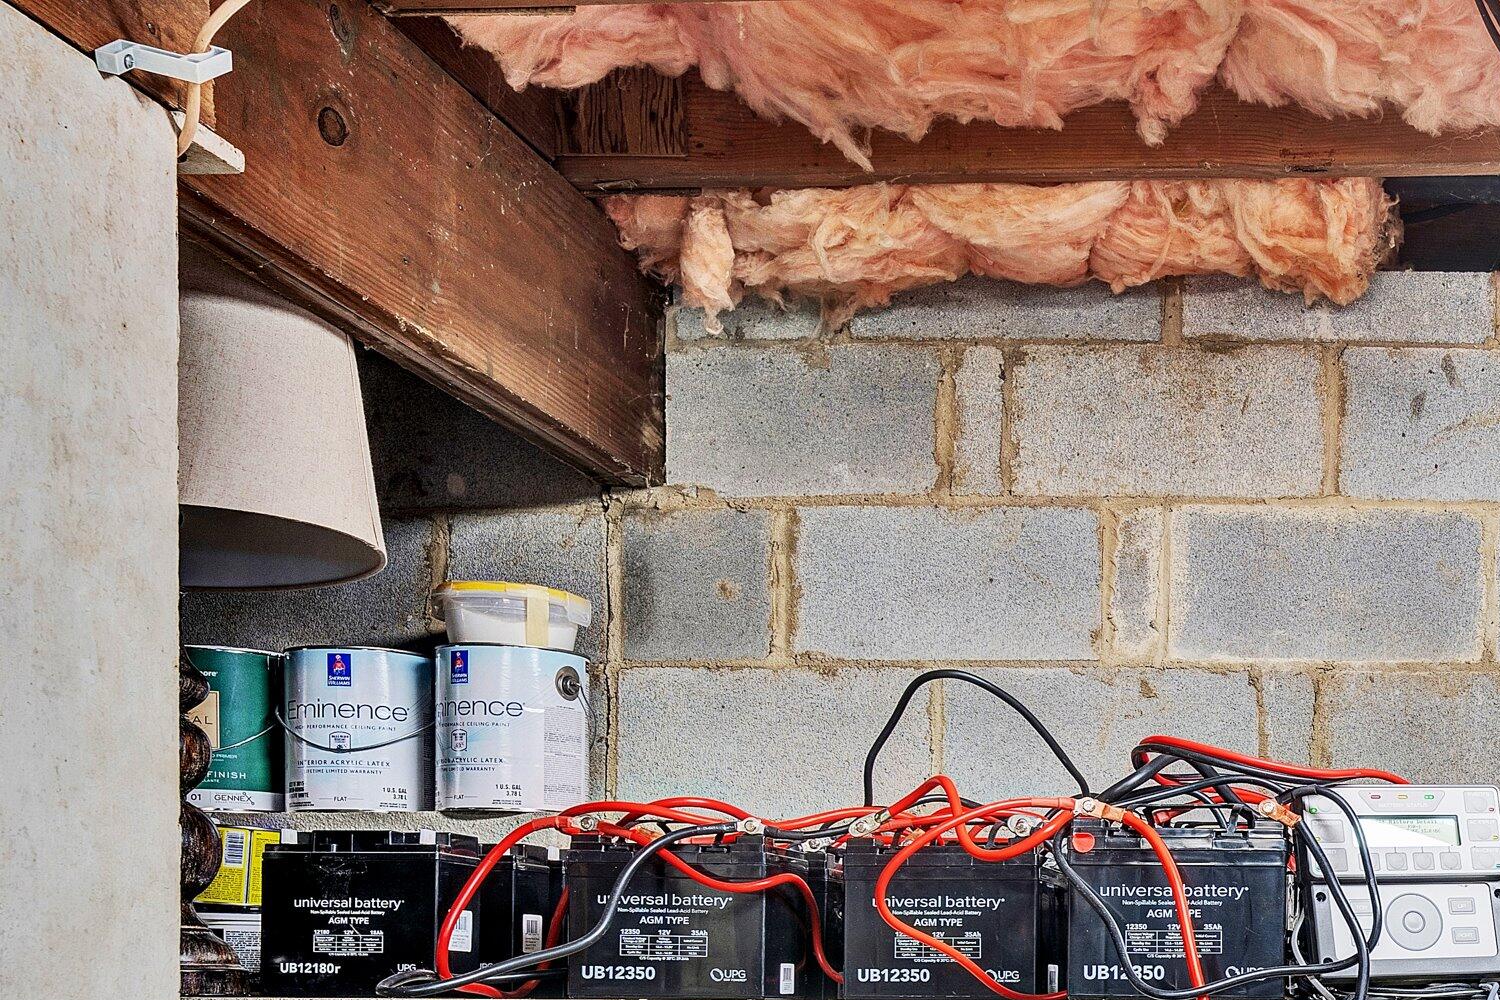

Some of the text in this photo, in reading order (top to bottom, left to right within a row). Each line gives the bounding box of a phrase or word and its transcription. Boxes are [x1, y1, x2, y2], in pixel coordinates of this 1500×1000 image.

[287, 698, 408, 722] Eminence
[206, 771, 247, 780] FINISH
[214, 792, 255, 805] GENNEX
[1099, 884, 1173, 897] universa
[293, 897, 402, 911] universal battery
[597, 894, 729, 909] uversal battery
[945, 895, 1001, 910] battery
[1203, 899, 1223, 907] Battery
[1146, 909, 1173, 918] AGM
[328, 917, 370, 925] AGM TYPE
[638, 916, 690, 925] AGM TYPE
[913, 918, 963, 927] AGM TYPE
[279, 962, 342, 974] UB12180r
[397, 963, 417, 972] UPG
[581, 965, 656, 980] UB12350
[724, 969, 746, 978] UPG
[857, 968, 931, 983] UB12350
[997, 970, 1020, 979] UPG
